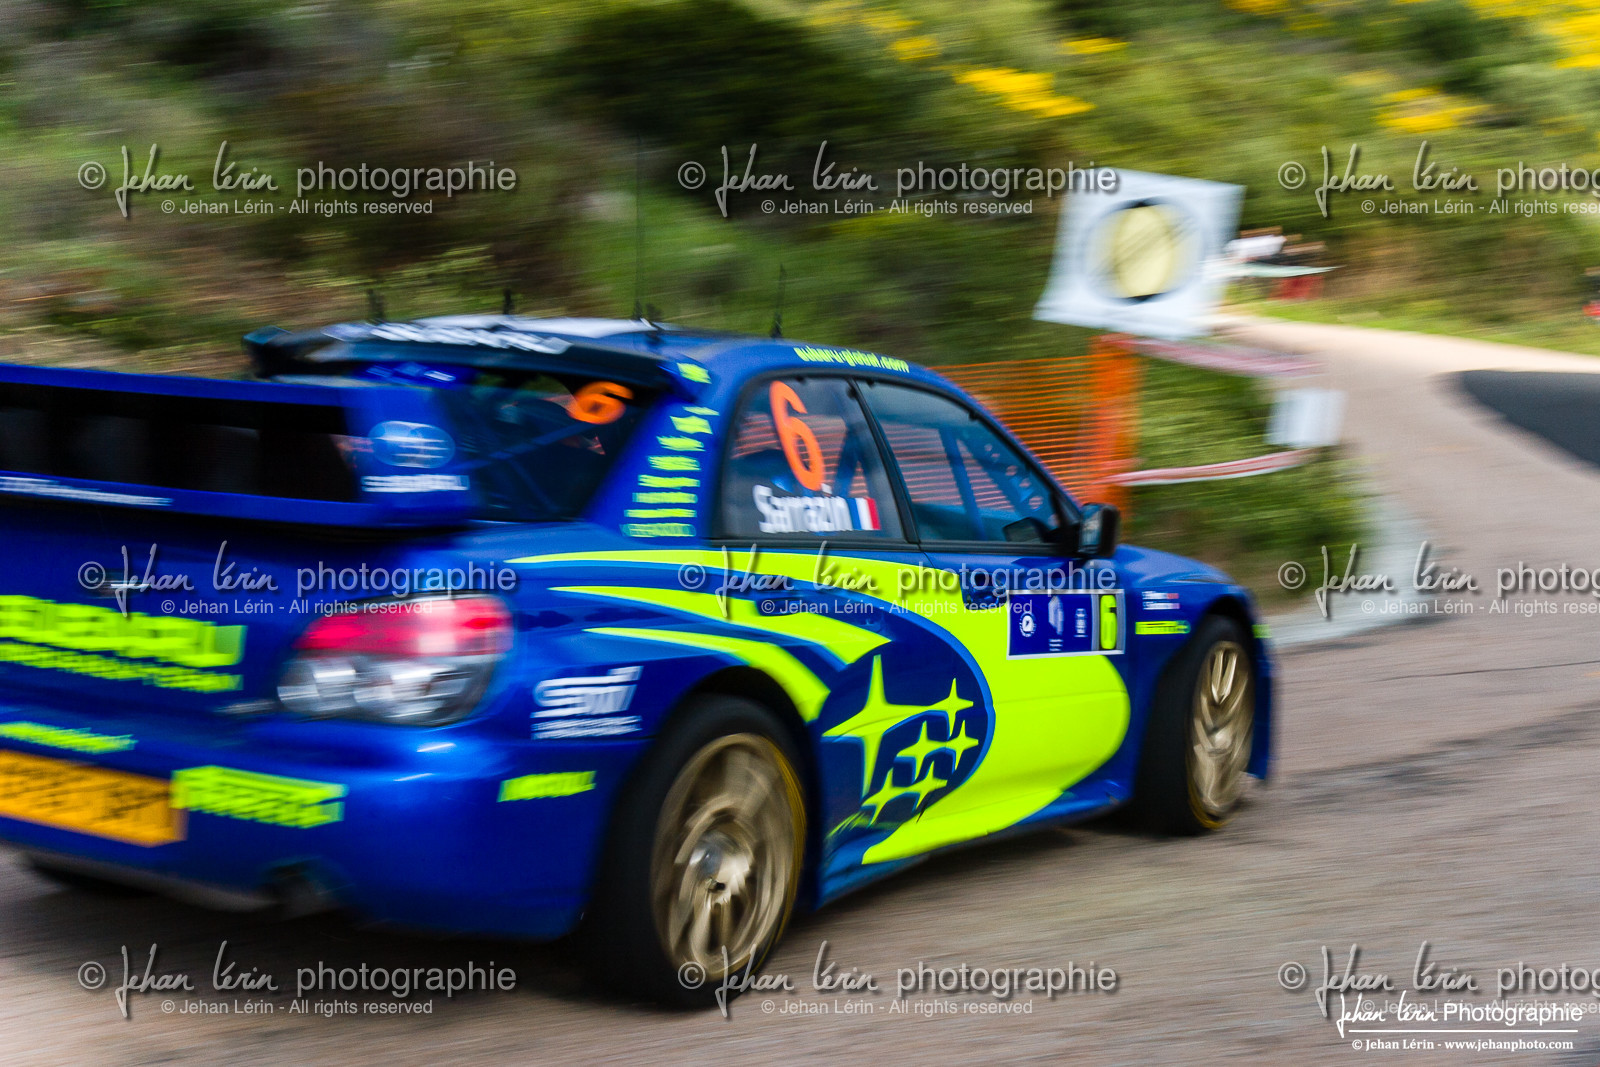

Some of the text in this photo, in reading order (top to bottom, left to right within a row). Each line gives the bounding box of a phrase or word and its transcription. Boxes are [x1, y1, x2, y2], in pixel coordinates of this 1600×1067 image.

[565, 381, 634, 425] 6
[769, 380, 826, 492] 6
[1100, 594, 1118, 650] 6
